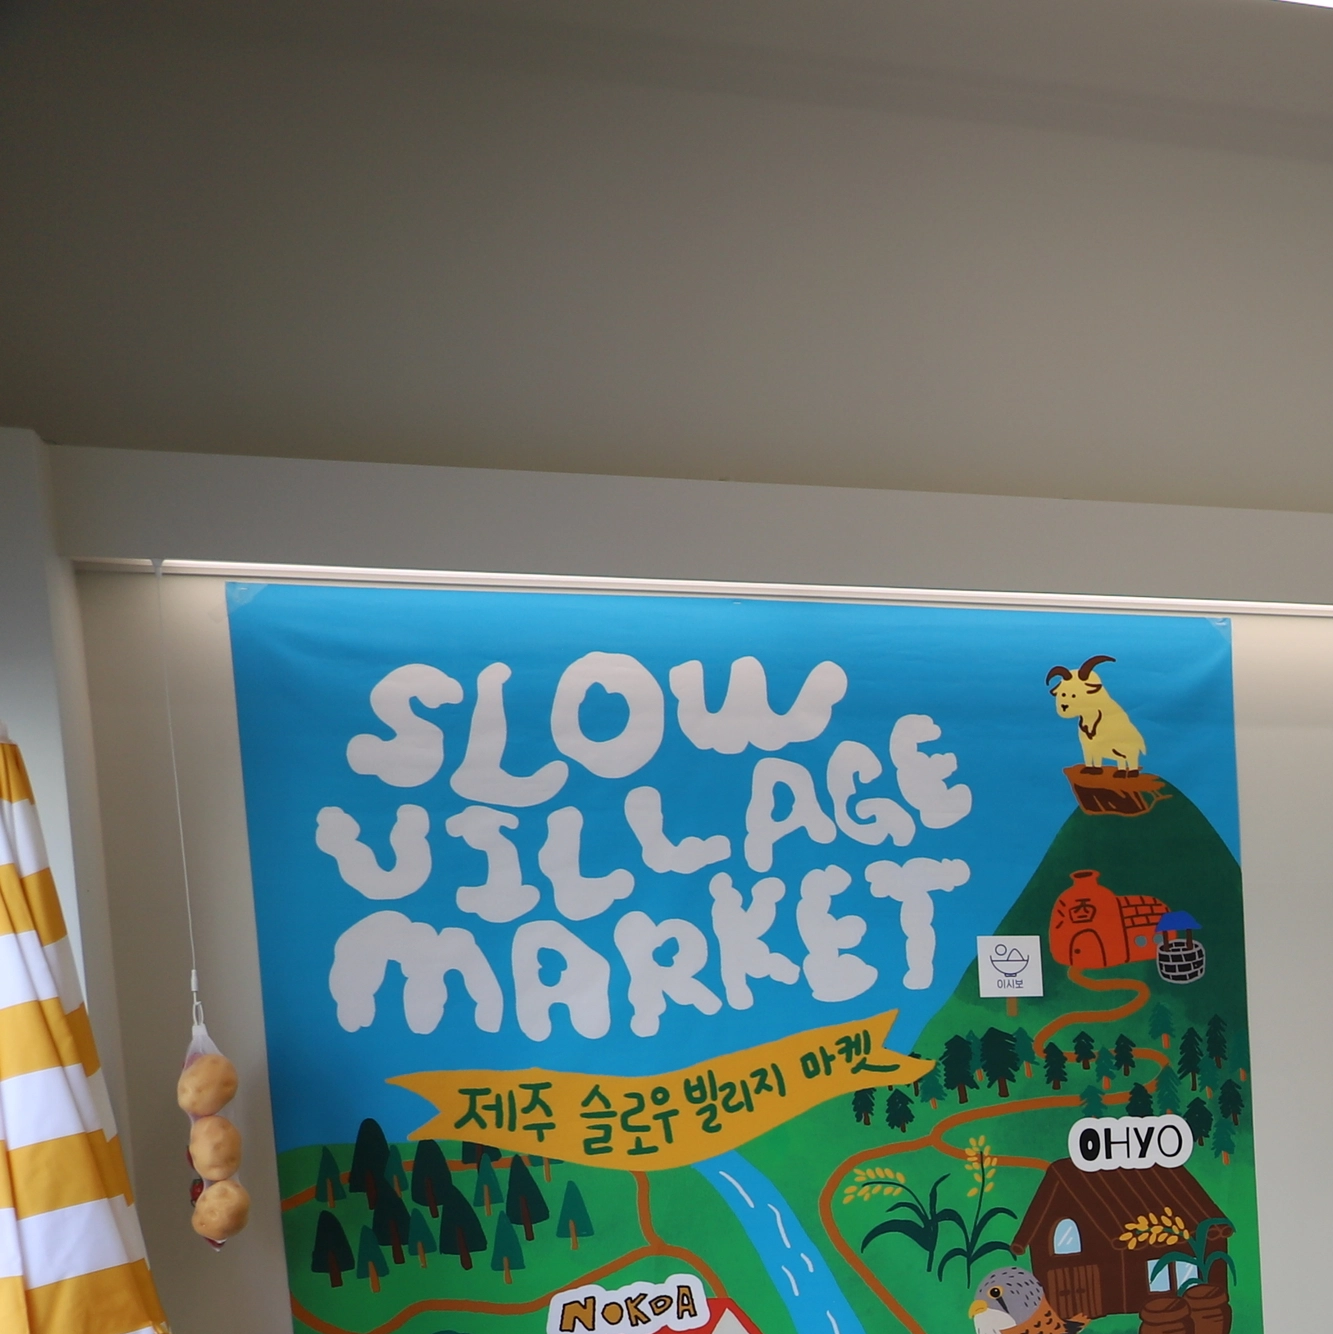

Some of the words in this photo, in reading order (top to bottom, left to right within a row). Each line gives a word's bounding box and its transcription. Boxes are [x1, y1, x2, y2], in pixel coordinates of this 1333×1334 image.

[346, 651, 848, 806] SLOW
[328, 857, 971, 1041] MARKET
[996, 978, 1024, 990] 이시보
[454, 1082, 556, 1142] 제주
[580, 1084, 680, 1156] 슬로우
[684, 1063, 786, 1134] 빌리지
[800, 1030, 900, 1079] 마켓
[1079, 1124, 1183, 1161] OHYO
[559, 1285, 698, 1332] NOKDA
